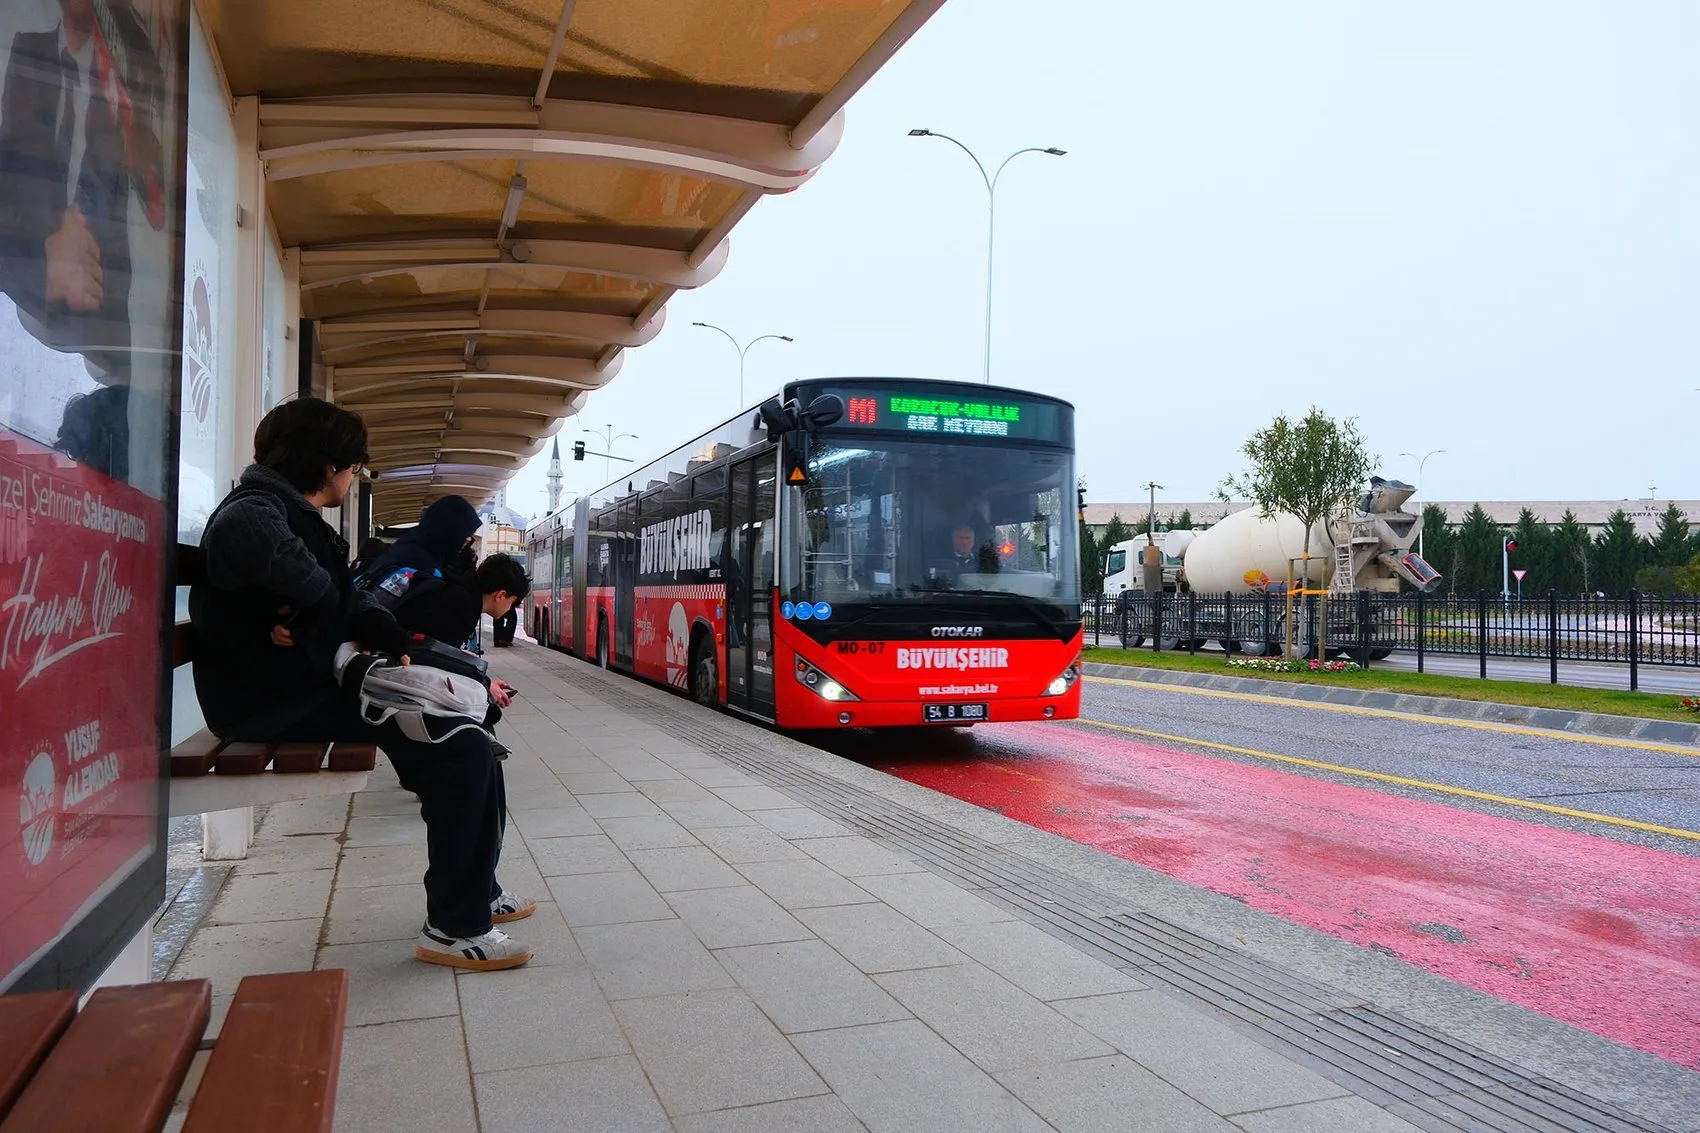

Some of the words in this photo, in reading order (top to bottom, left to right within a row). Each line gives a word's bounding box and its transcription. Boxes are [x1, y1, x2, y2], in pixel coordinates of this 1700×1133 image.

[849, 397, 877, 424] M1
[30, 473, 81, 525] Şehrimiz
[931, 626, 983, 638] OTOKAR
[896, 647, 1009, 671] BÜYÜKŞEHİR
[918, 684, 999, 696] www.sakarya.bel.tr
[928, 705, 941, 719] 54
[947, 704, 955, 718] B
[64, 719, 101, 765] YUSUF
[63, 751, 120, 811] ALEMDAR
